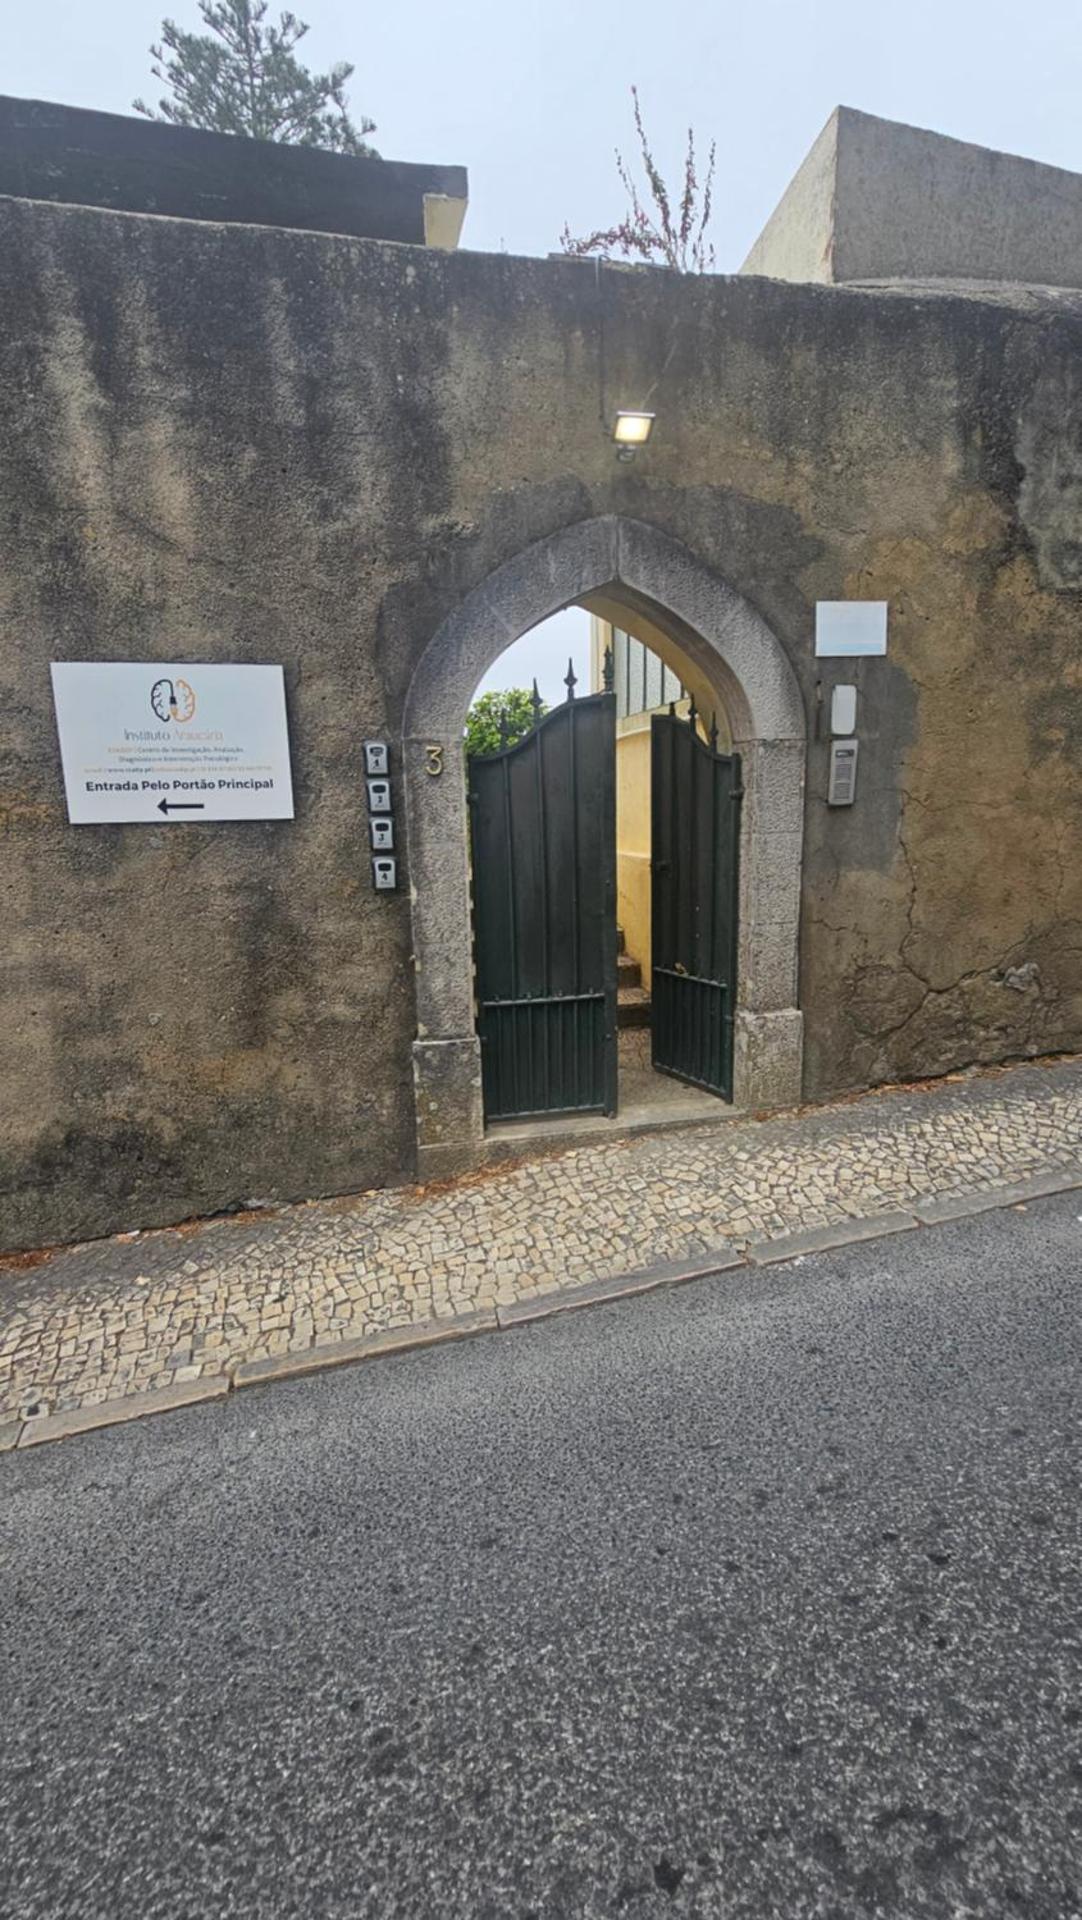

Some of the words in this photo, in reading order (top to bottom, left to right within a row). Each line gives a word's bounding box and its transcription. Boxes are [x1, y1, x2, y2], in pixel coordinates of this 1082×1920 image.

[124, 728, 170, 741] Instituto
[425, 745, 443, 776] 3
[86, 780, 138, 792] Entrada
[141, 780, 170, 791] Pelo
[172, 778, 216, 790] Portão
[218, 777, 274, 791] Principal
